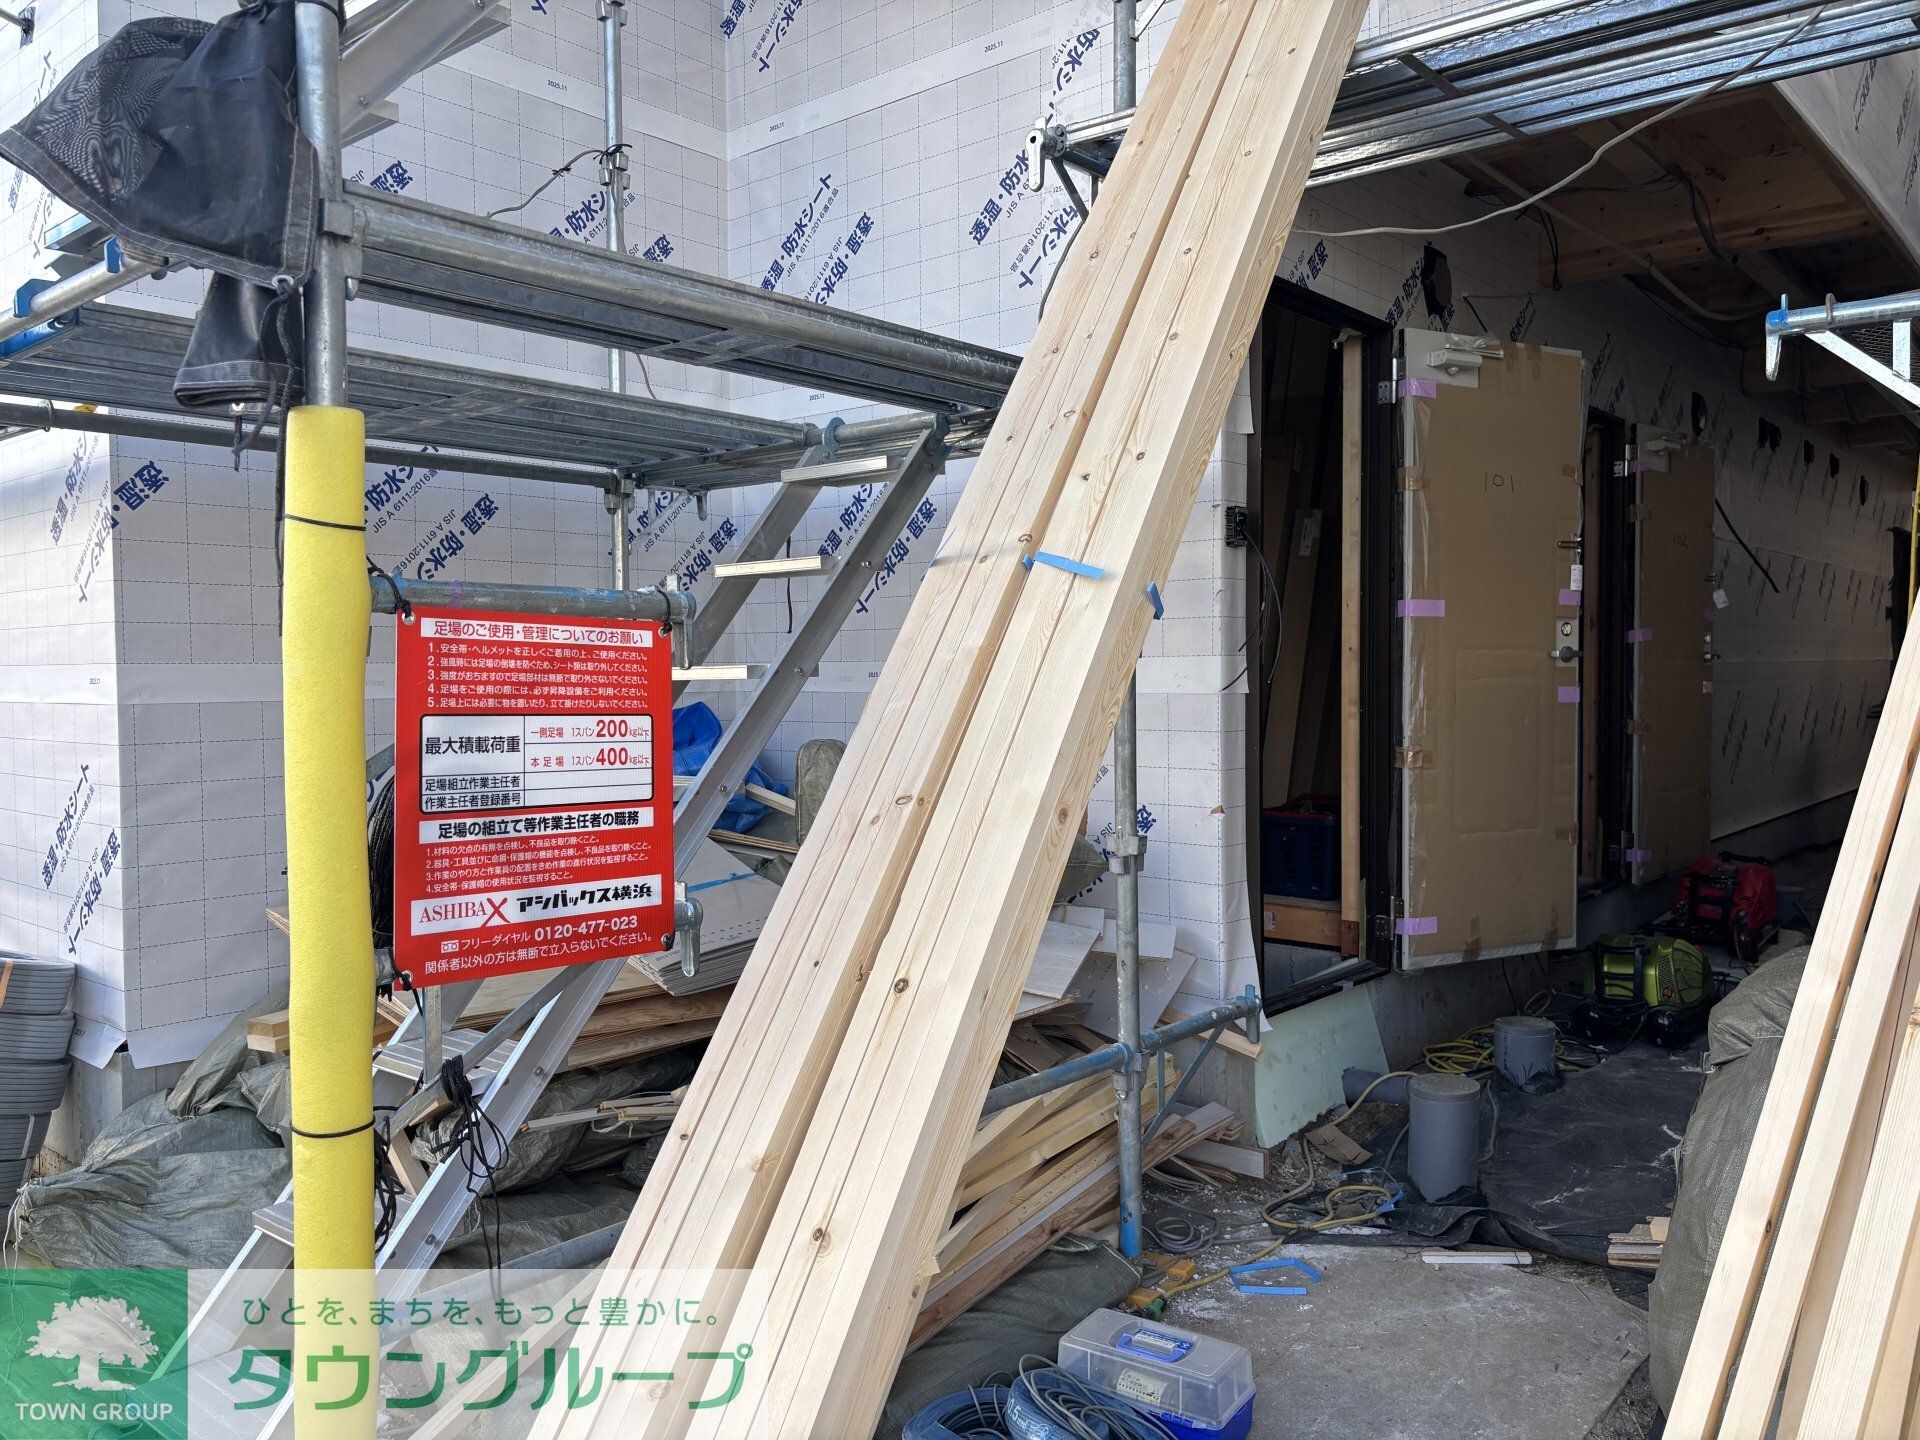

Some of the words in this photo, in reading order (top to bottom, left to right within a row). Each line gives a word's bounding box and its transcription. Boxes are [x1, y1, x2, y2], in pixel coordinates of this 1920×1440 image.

[1484, 472, 1515, 493] 101
[373, 517, 387, 534] JIS
[443, 508, 457, 525] JIS
[434, 621, 643, 645] 足場のご使用・管理についてのお願い
[531, 727, 564, 739] 一側足場
[425, 736, 521, 755] 最大積載荷重
[425, 775, 520, 792] 足場組立作業主任者
[425, 793, 521, 810] 作業主任者登録番号
[438, 810, 639, 839] 足場の組立て等作業主任者の職務
[517, 882, 653, 913] アシバックス横浜
[461, 931, 530, 952] フリーダイヤル
[534, 915, 638, 942] 0120-477-023
[425, 931, 652, 975] 関係者以外の方は無断で立入らないでください。
